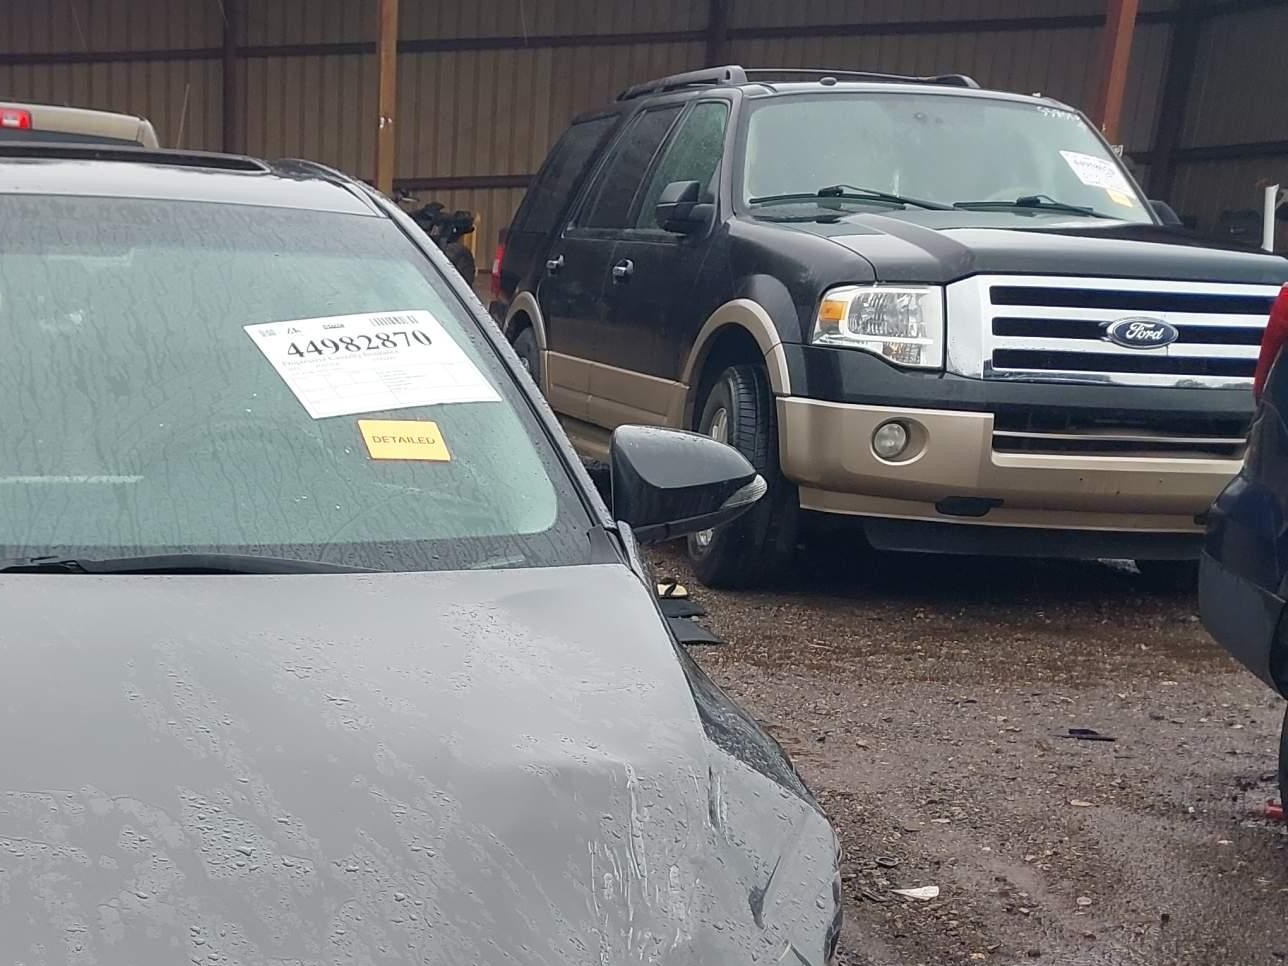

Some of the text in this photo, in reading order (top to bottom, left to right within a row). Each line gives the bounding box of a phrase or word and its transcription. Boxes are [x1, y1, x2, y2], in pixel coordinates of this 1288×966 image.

[1126, 322, 1164, 340] Ford
[287, 329, 432, 358] 44982870
[372, 435, 436, 446] DETAILED
